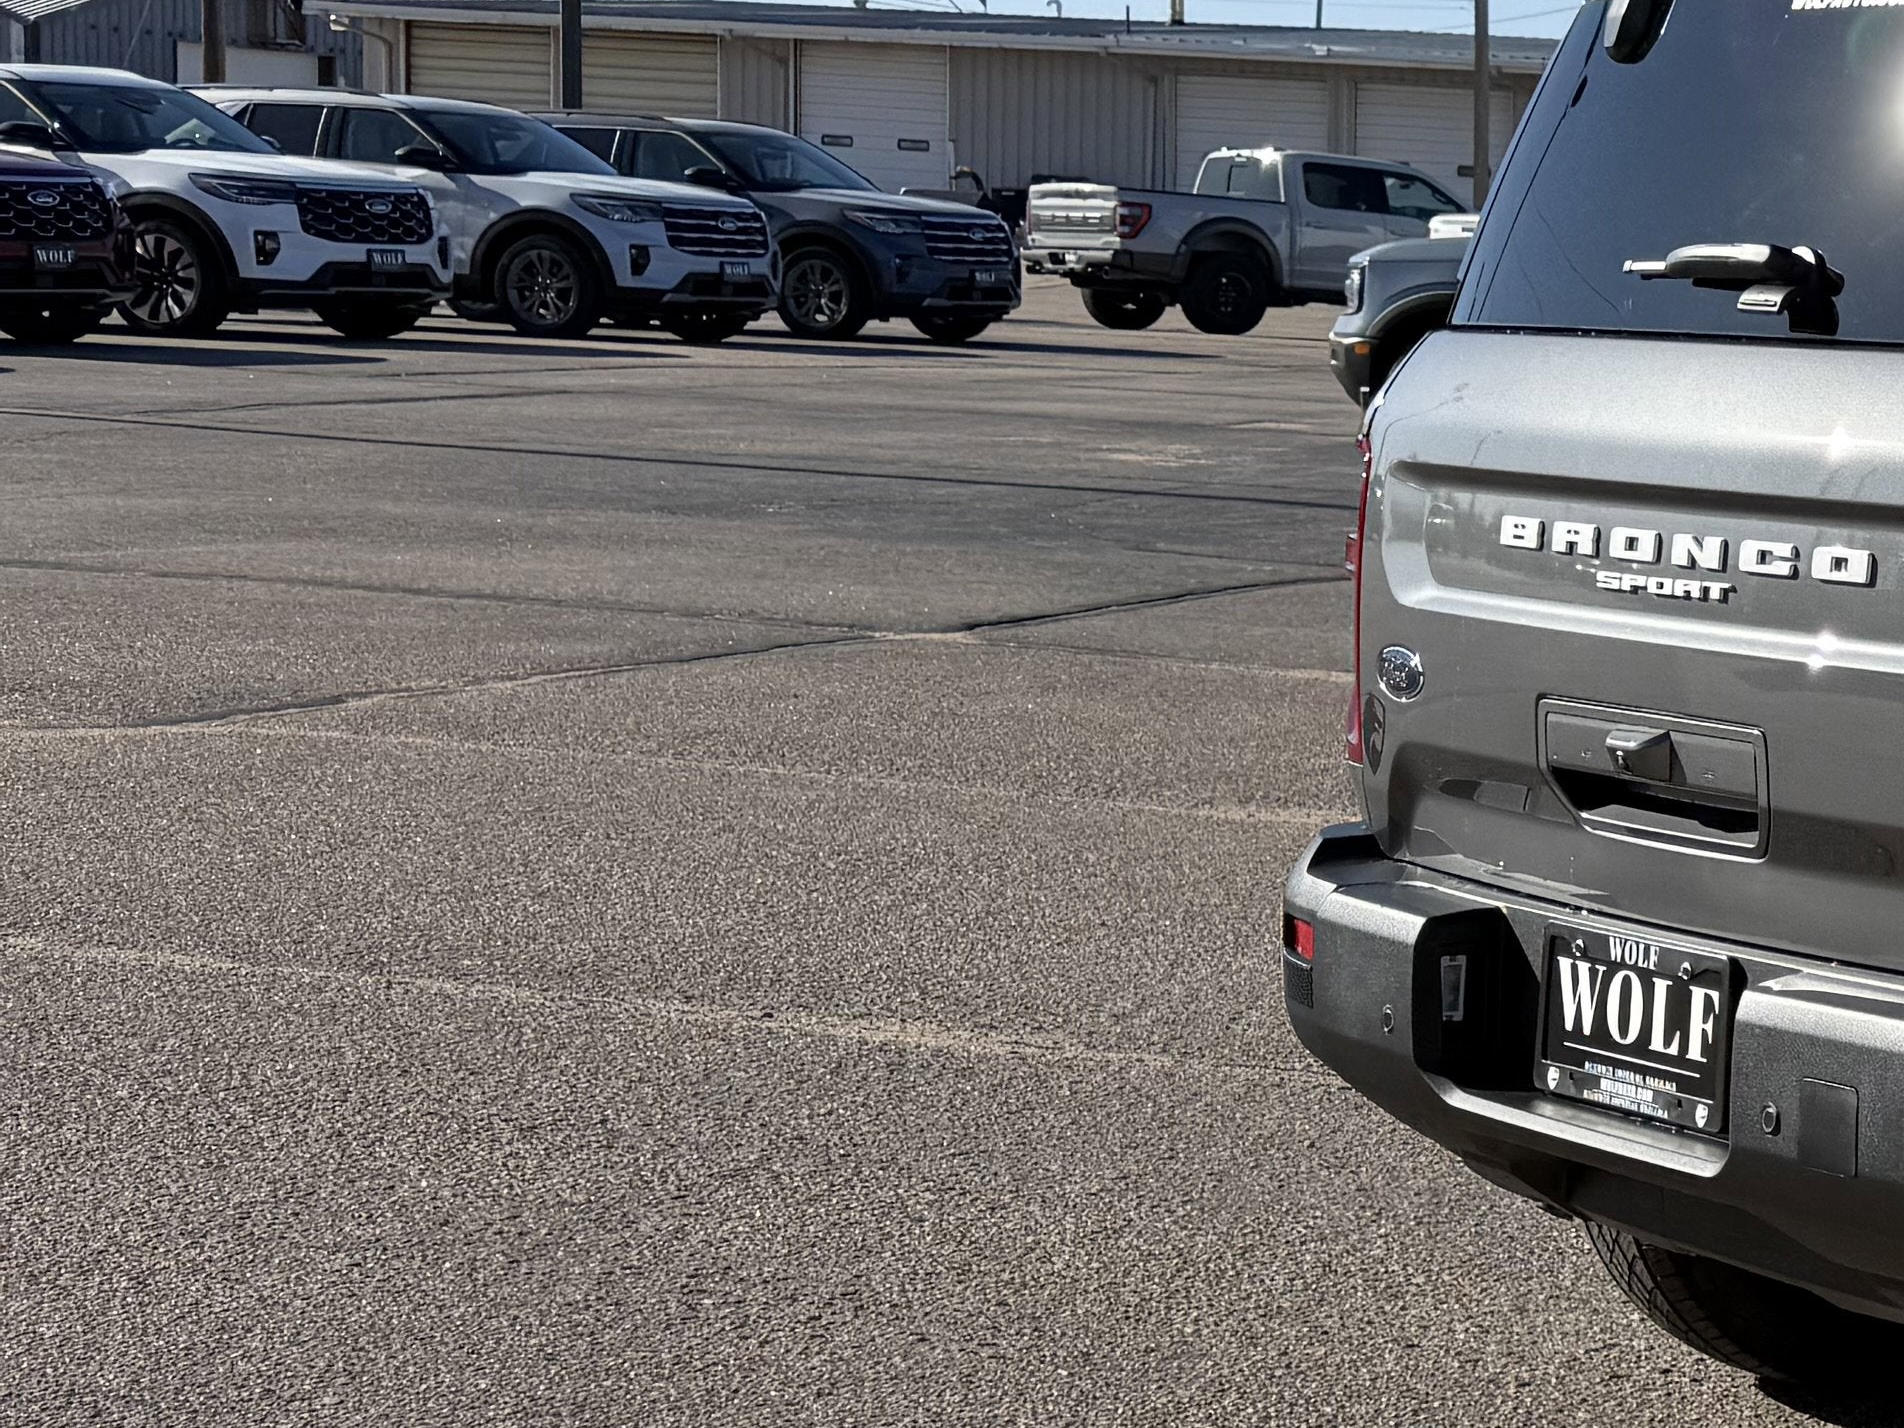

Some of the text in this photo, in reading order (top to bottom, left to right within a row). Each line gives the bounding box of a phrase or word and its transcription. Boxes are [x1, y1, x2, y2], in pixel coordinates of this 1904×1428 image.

[1499, 514, 1876, 588] BRONCO
[1596, 570, 1735, 603] SPORT
[1608, 936, 1660, 970] WOLF
[1557, 955, 1720, 1063] WOLF
